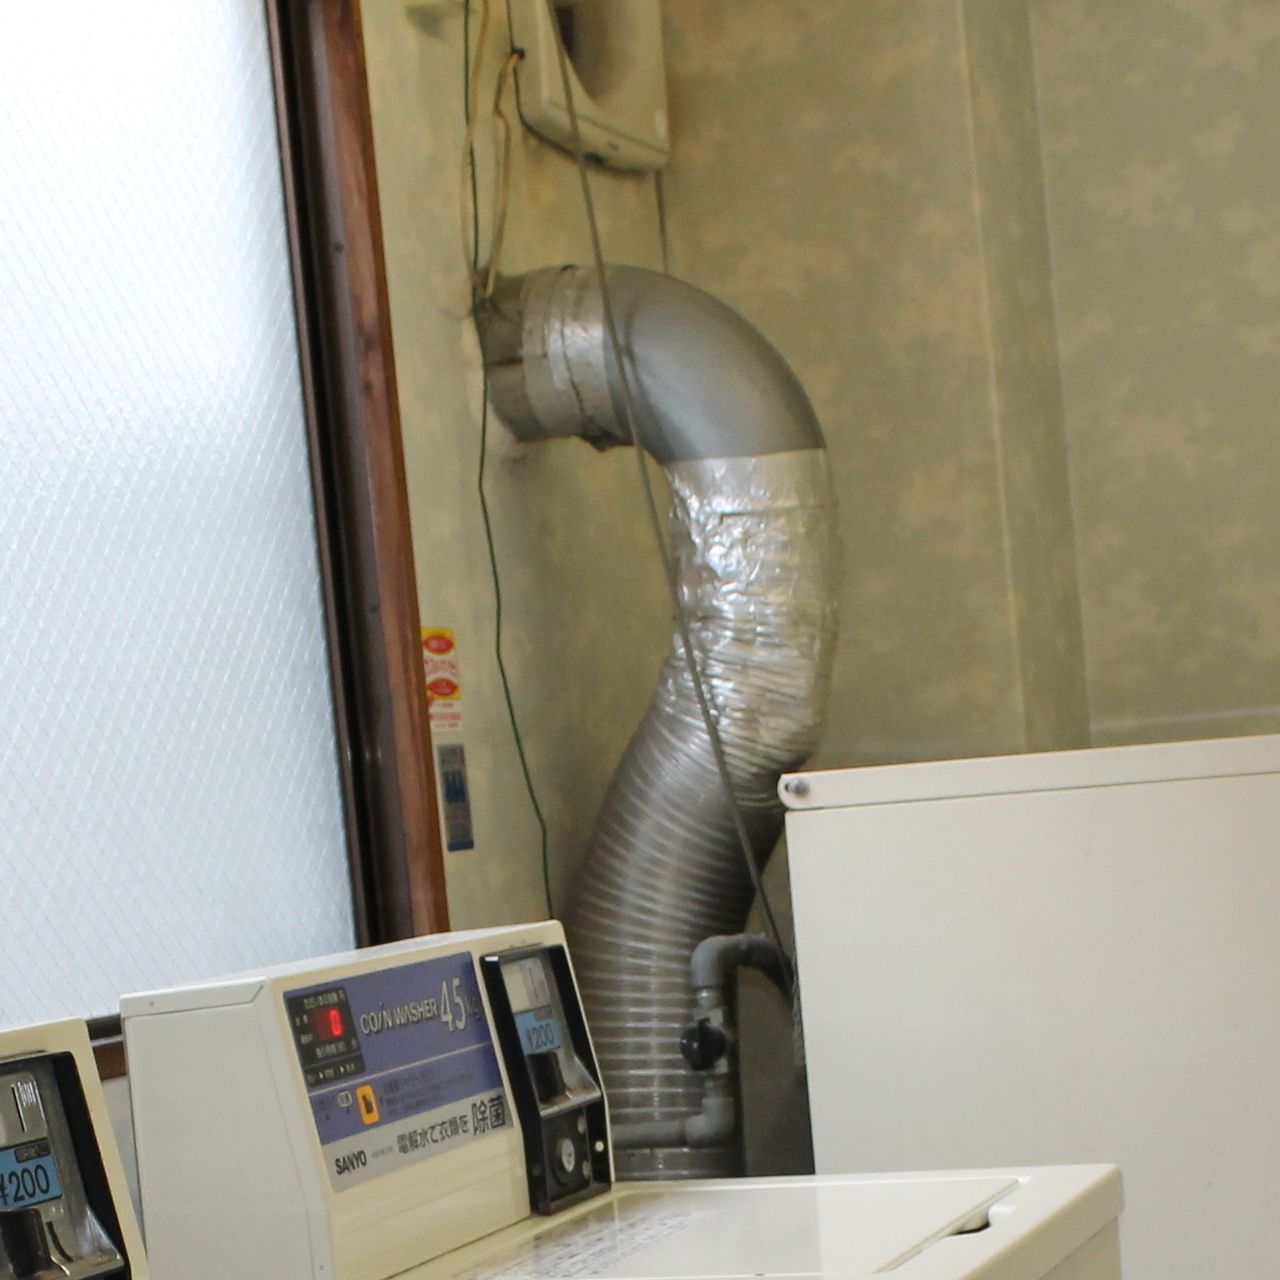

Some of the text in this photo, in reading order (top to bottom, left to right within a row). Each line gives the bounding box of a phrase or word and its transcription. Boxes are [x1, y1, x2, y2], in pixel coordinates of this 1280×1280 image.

[393, 998, 438, 1025] WASHER
[471, 1095, 507, 1136] 除菌
[335, 1150, 367, 1175] SANYO
